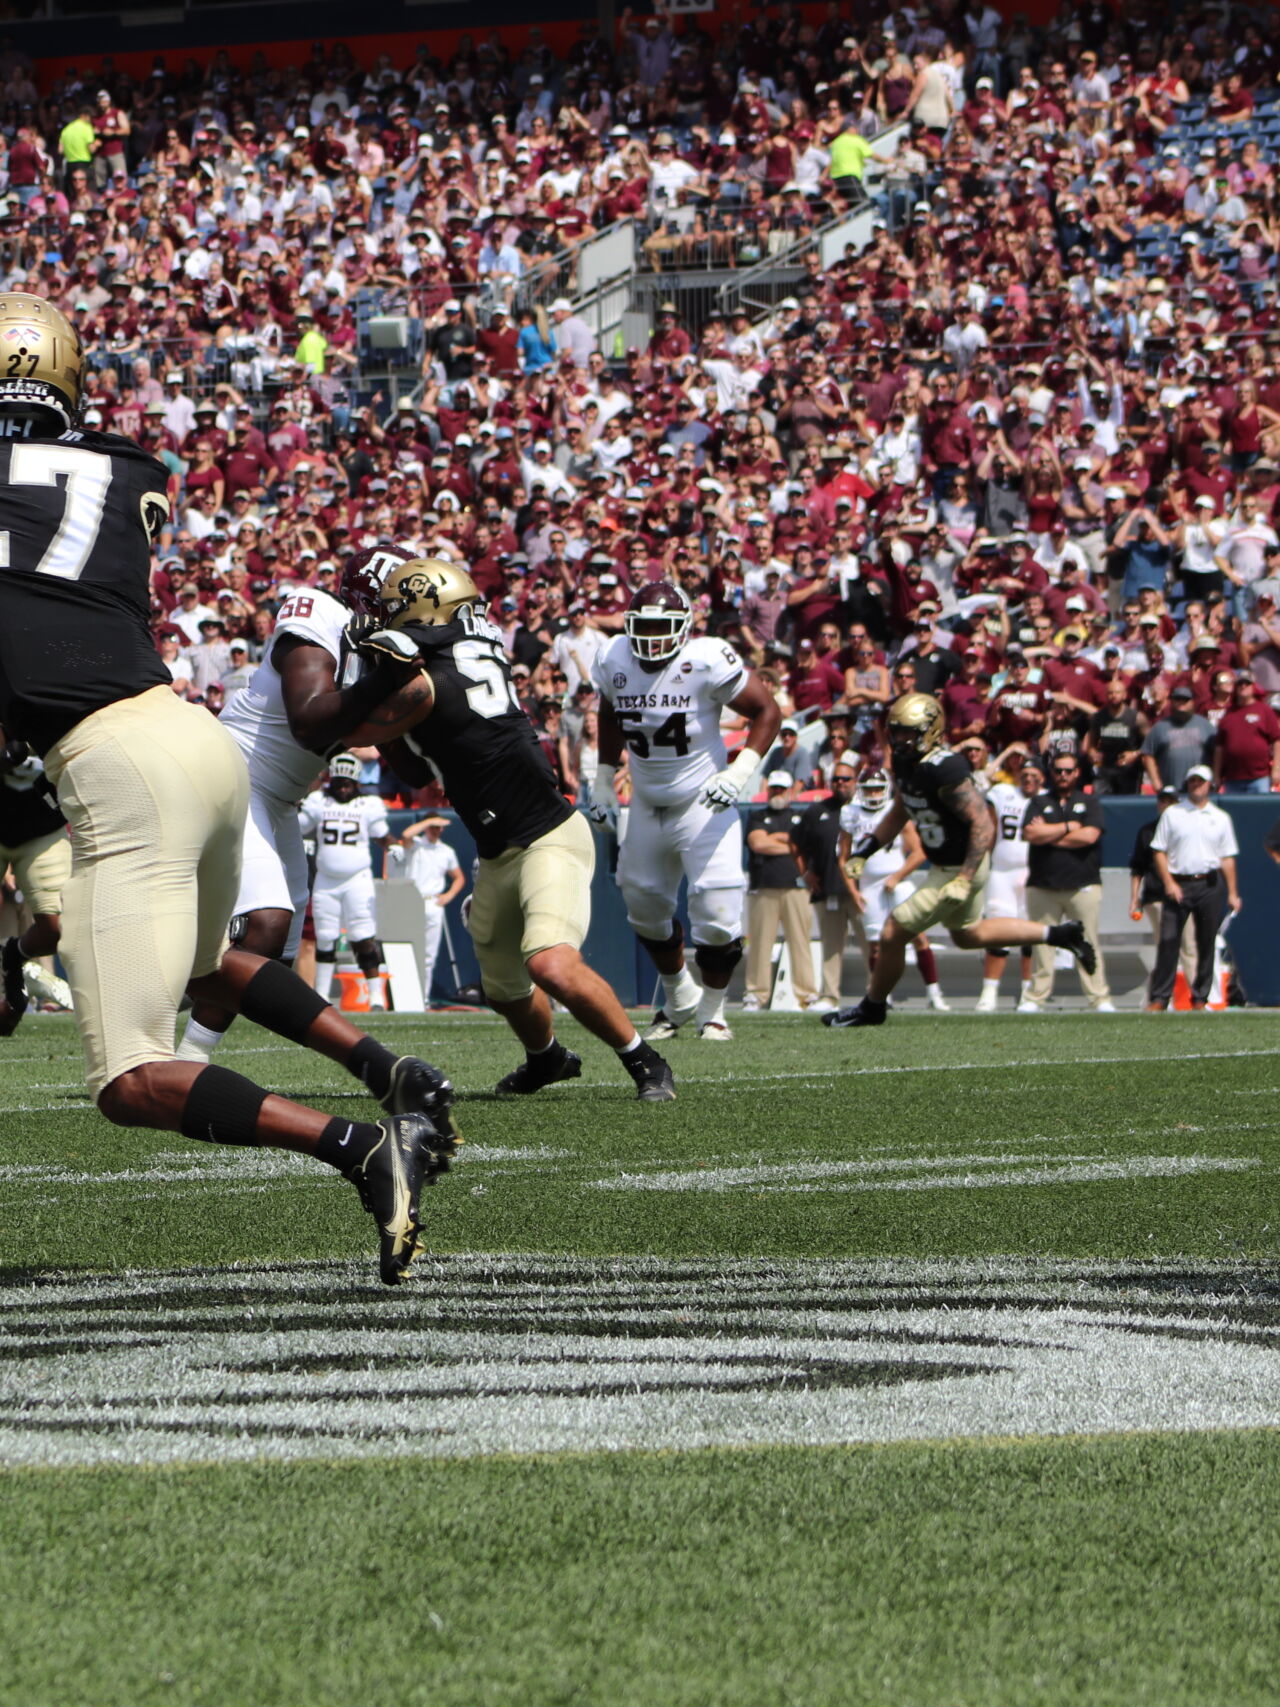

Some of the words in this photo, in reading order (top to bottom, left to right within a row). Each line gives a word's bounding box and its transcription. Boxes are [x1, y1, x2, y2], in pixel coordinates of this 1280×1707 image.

[7, 354, 40, 378] 27
[279, 596, 314, 619] 58
[453, 640, 521, 719] 5
[617, 695, 656, 709] TEXAS
[661, 695, 691, 708] A&M
[322, 820, 360, 846] 52
[1002, 815, 1023, 841] 6
